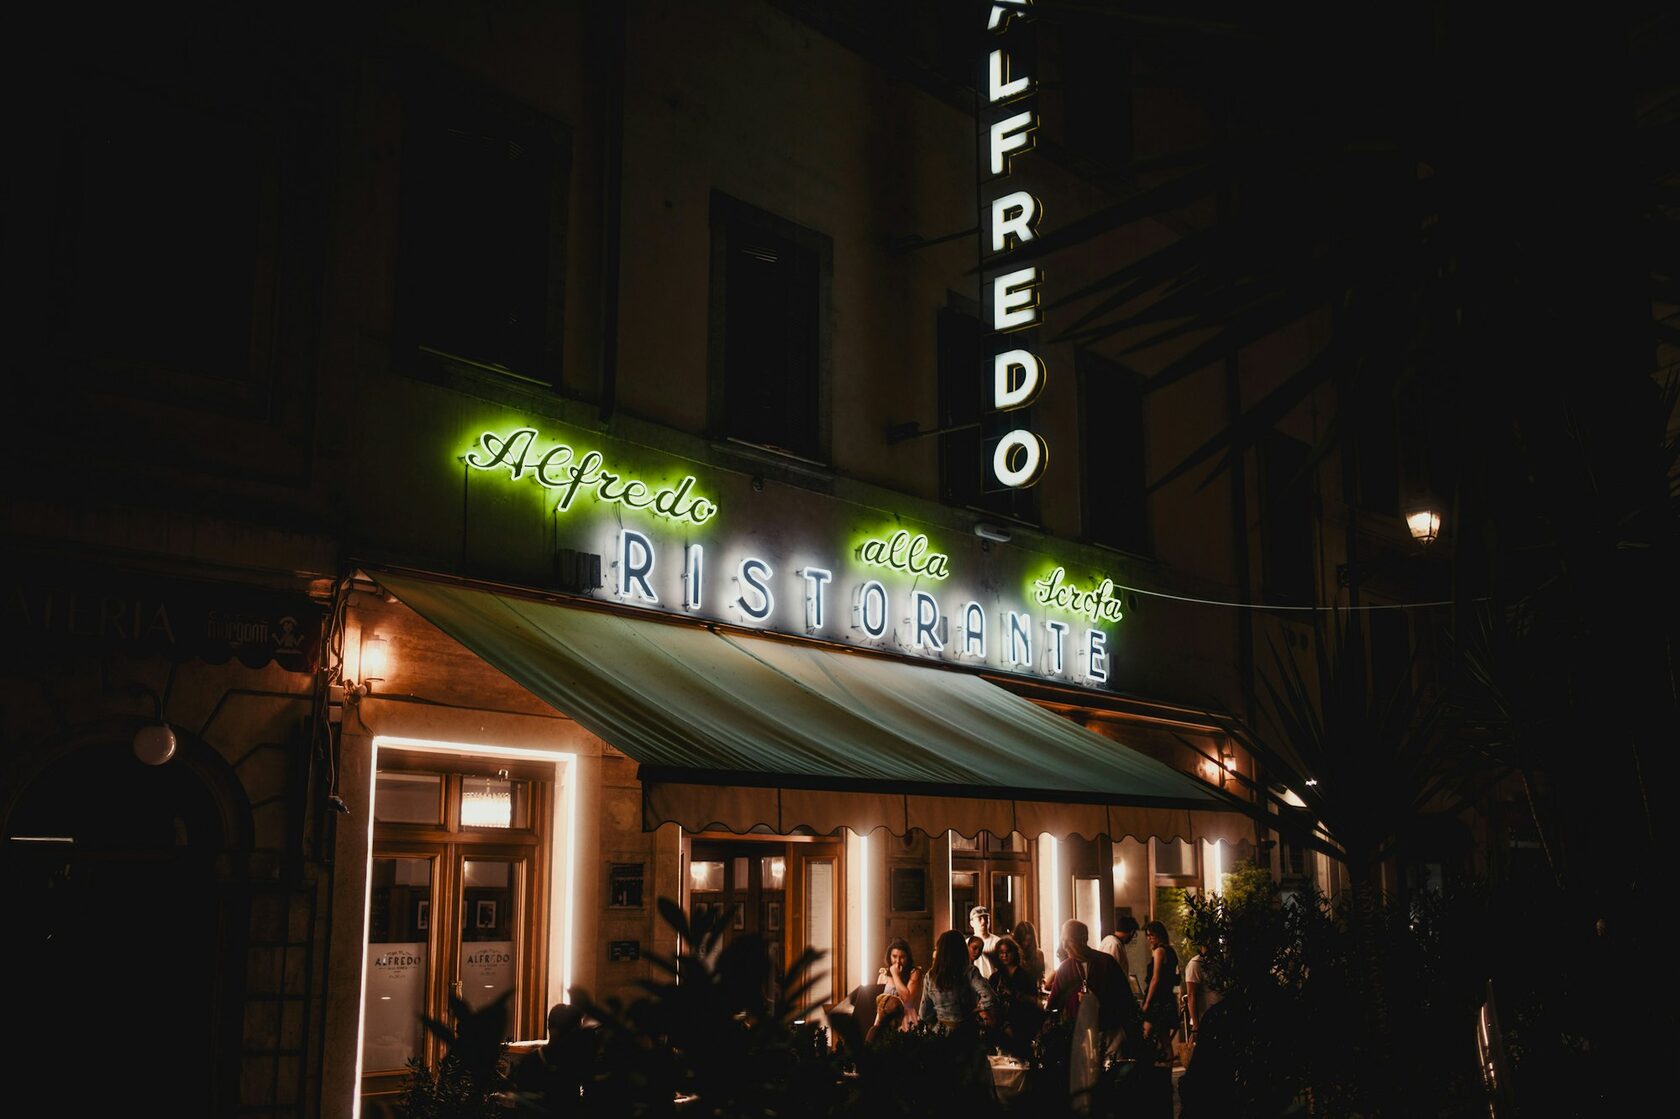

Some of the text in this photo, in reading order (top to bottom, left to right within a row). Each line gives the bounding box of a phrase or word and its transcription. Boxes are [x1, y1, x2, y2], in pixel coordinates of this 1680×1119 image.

[465, 428, 1123, 623] Alfredo alla Scrofa
[619, 527, 1109, 684] RISTORANTE
